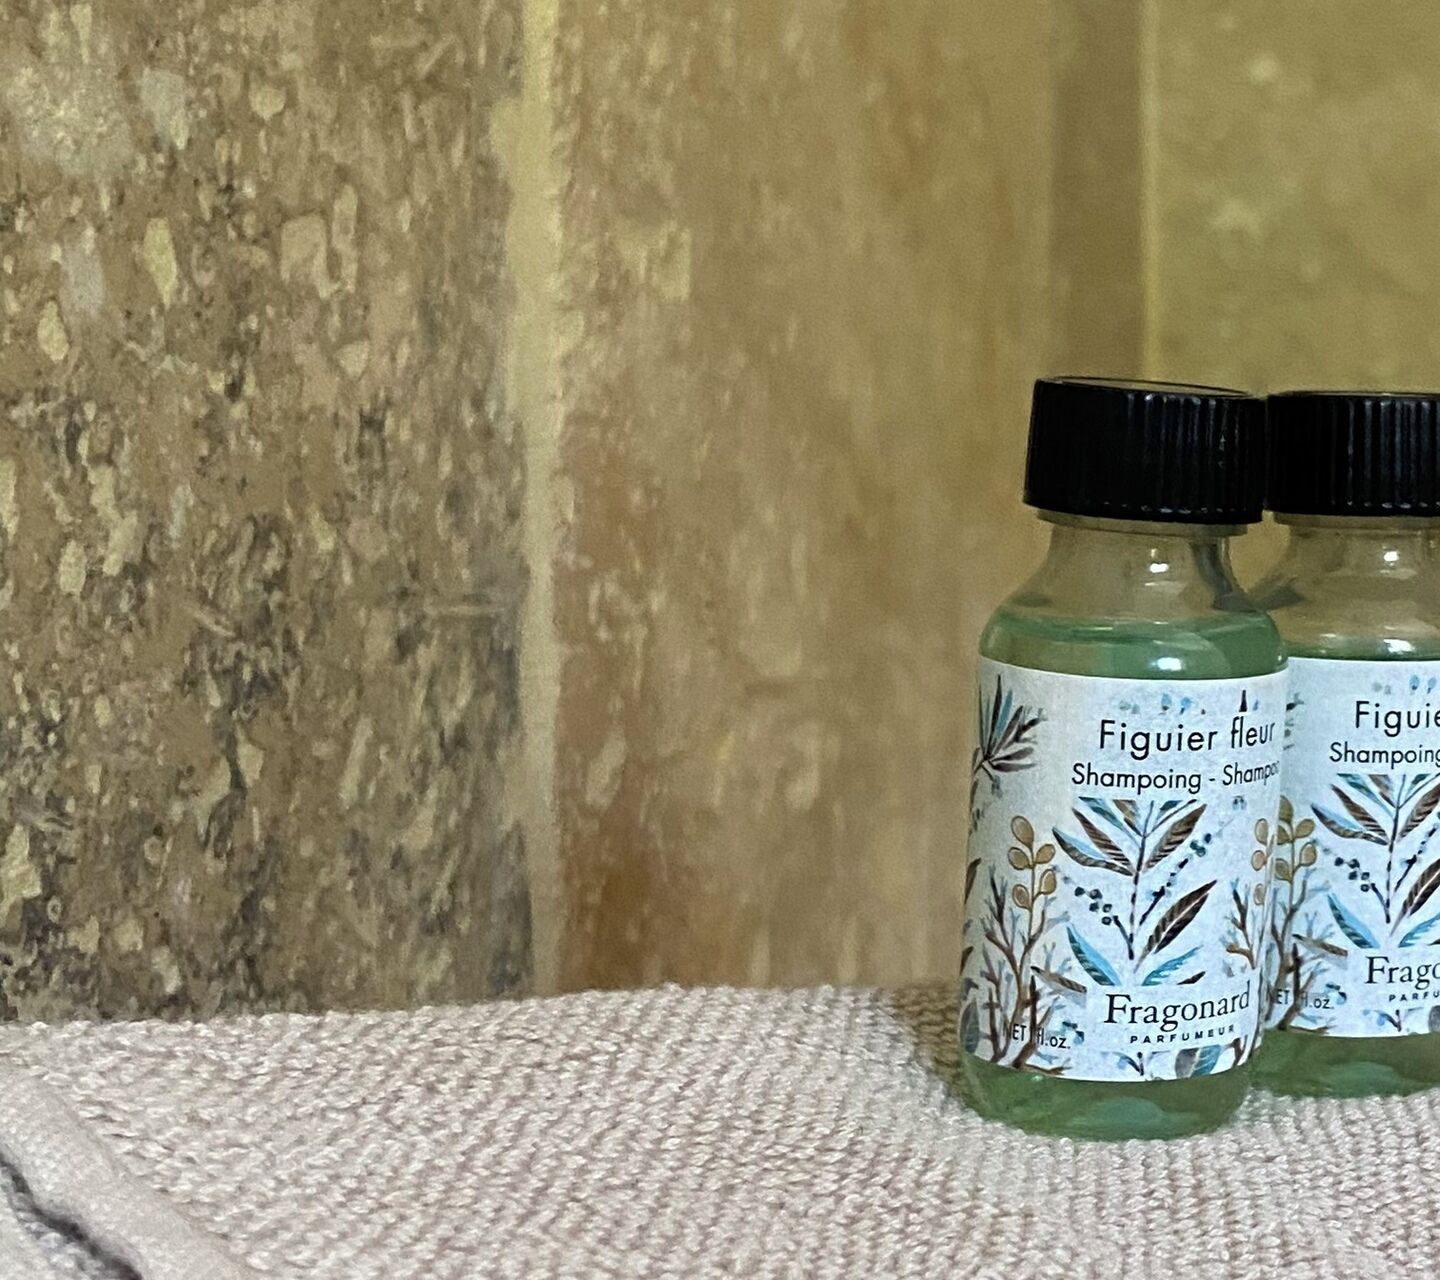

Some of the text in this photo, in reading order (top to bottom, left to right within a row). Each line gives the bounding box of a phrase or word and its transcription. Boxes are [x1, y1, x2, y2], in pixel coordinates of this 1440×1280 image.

[1099, 716, 1276, 760] Figuier fleur
[1070, 762, 1202, 795] Shampoing
[1104, 979, 1251, 1032] Fragonard
[1129, 1024, 1234, 1044] PARFUMEUR
